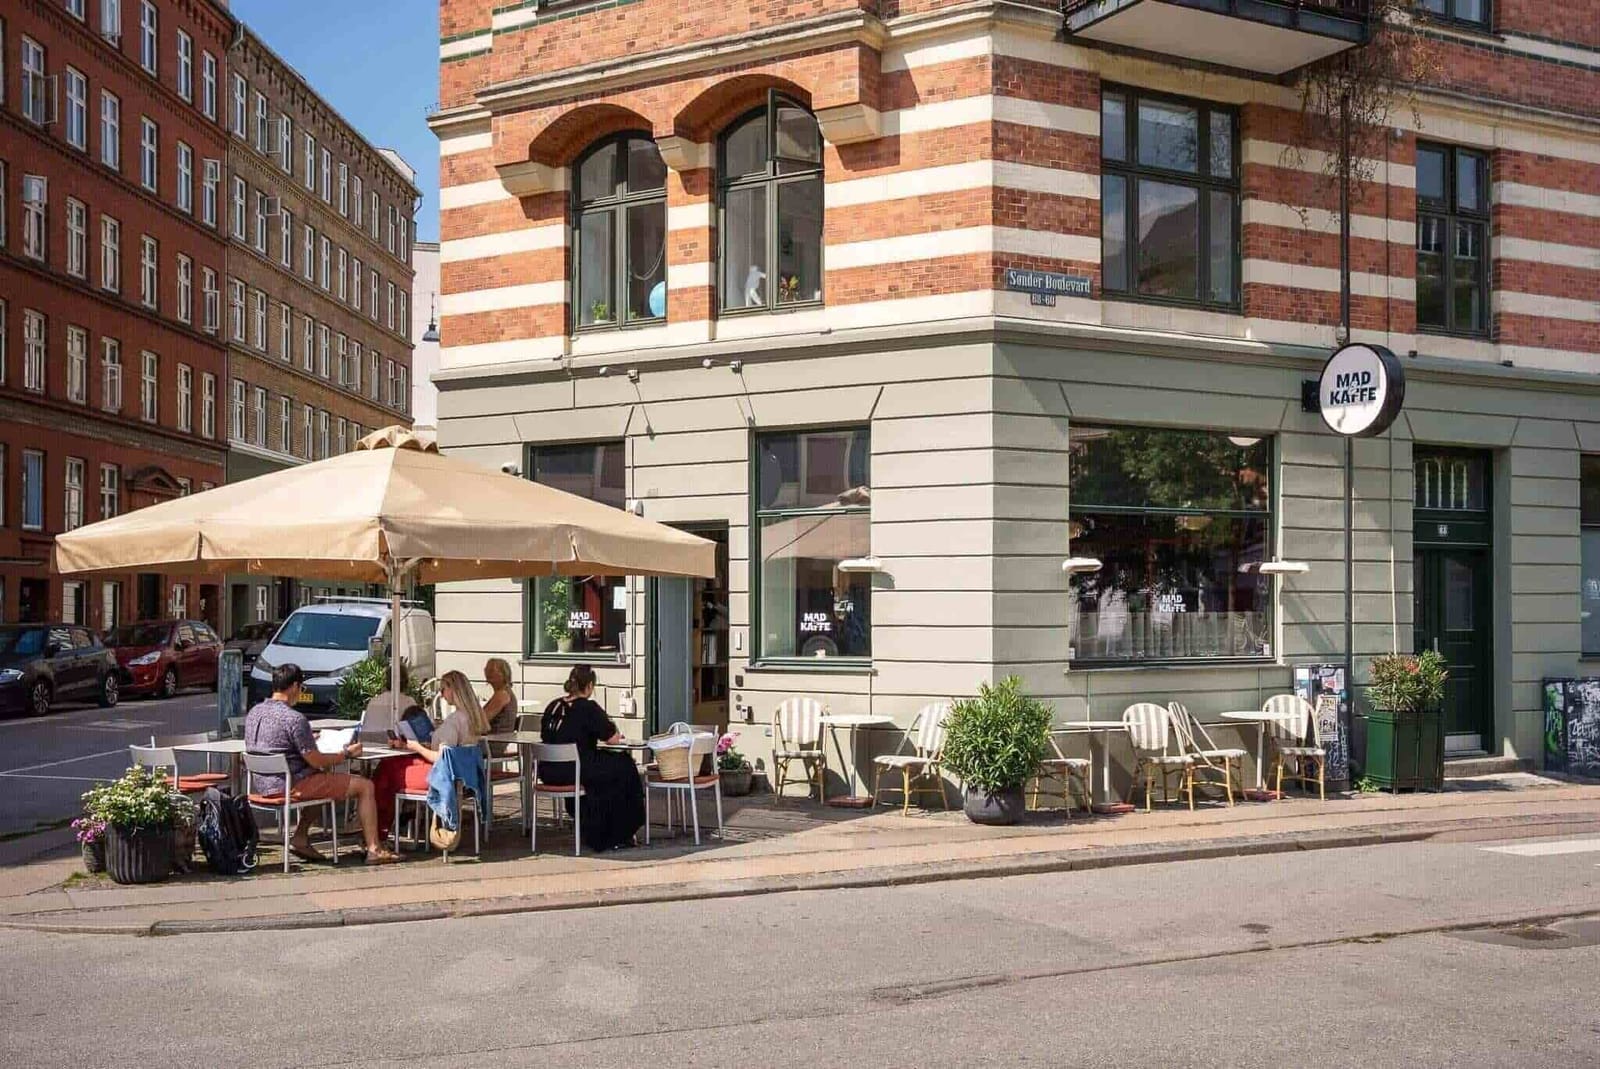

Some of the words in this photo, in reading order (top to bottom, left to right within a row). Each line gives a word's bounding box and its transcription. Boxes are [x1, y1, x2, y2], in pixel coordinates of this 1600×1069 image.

[1010, 271, 1043, 289] Sønder
[1045, 275, 1090, 293] Boulevard
[1336, 371, 1371, 388] MAD
[1330, 387, 1377, 405] KAFFE
[1162, 594, 1183, 603] MAD
[570, 611, 590, 620] MAD
[804, 612, 827, 621] MAD
